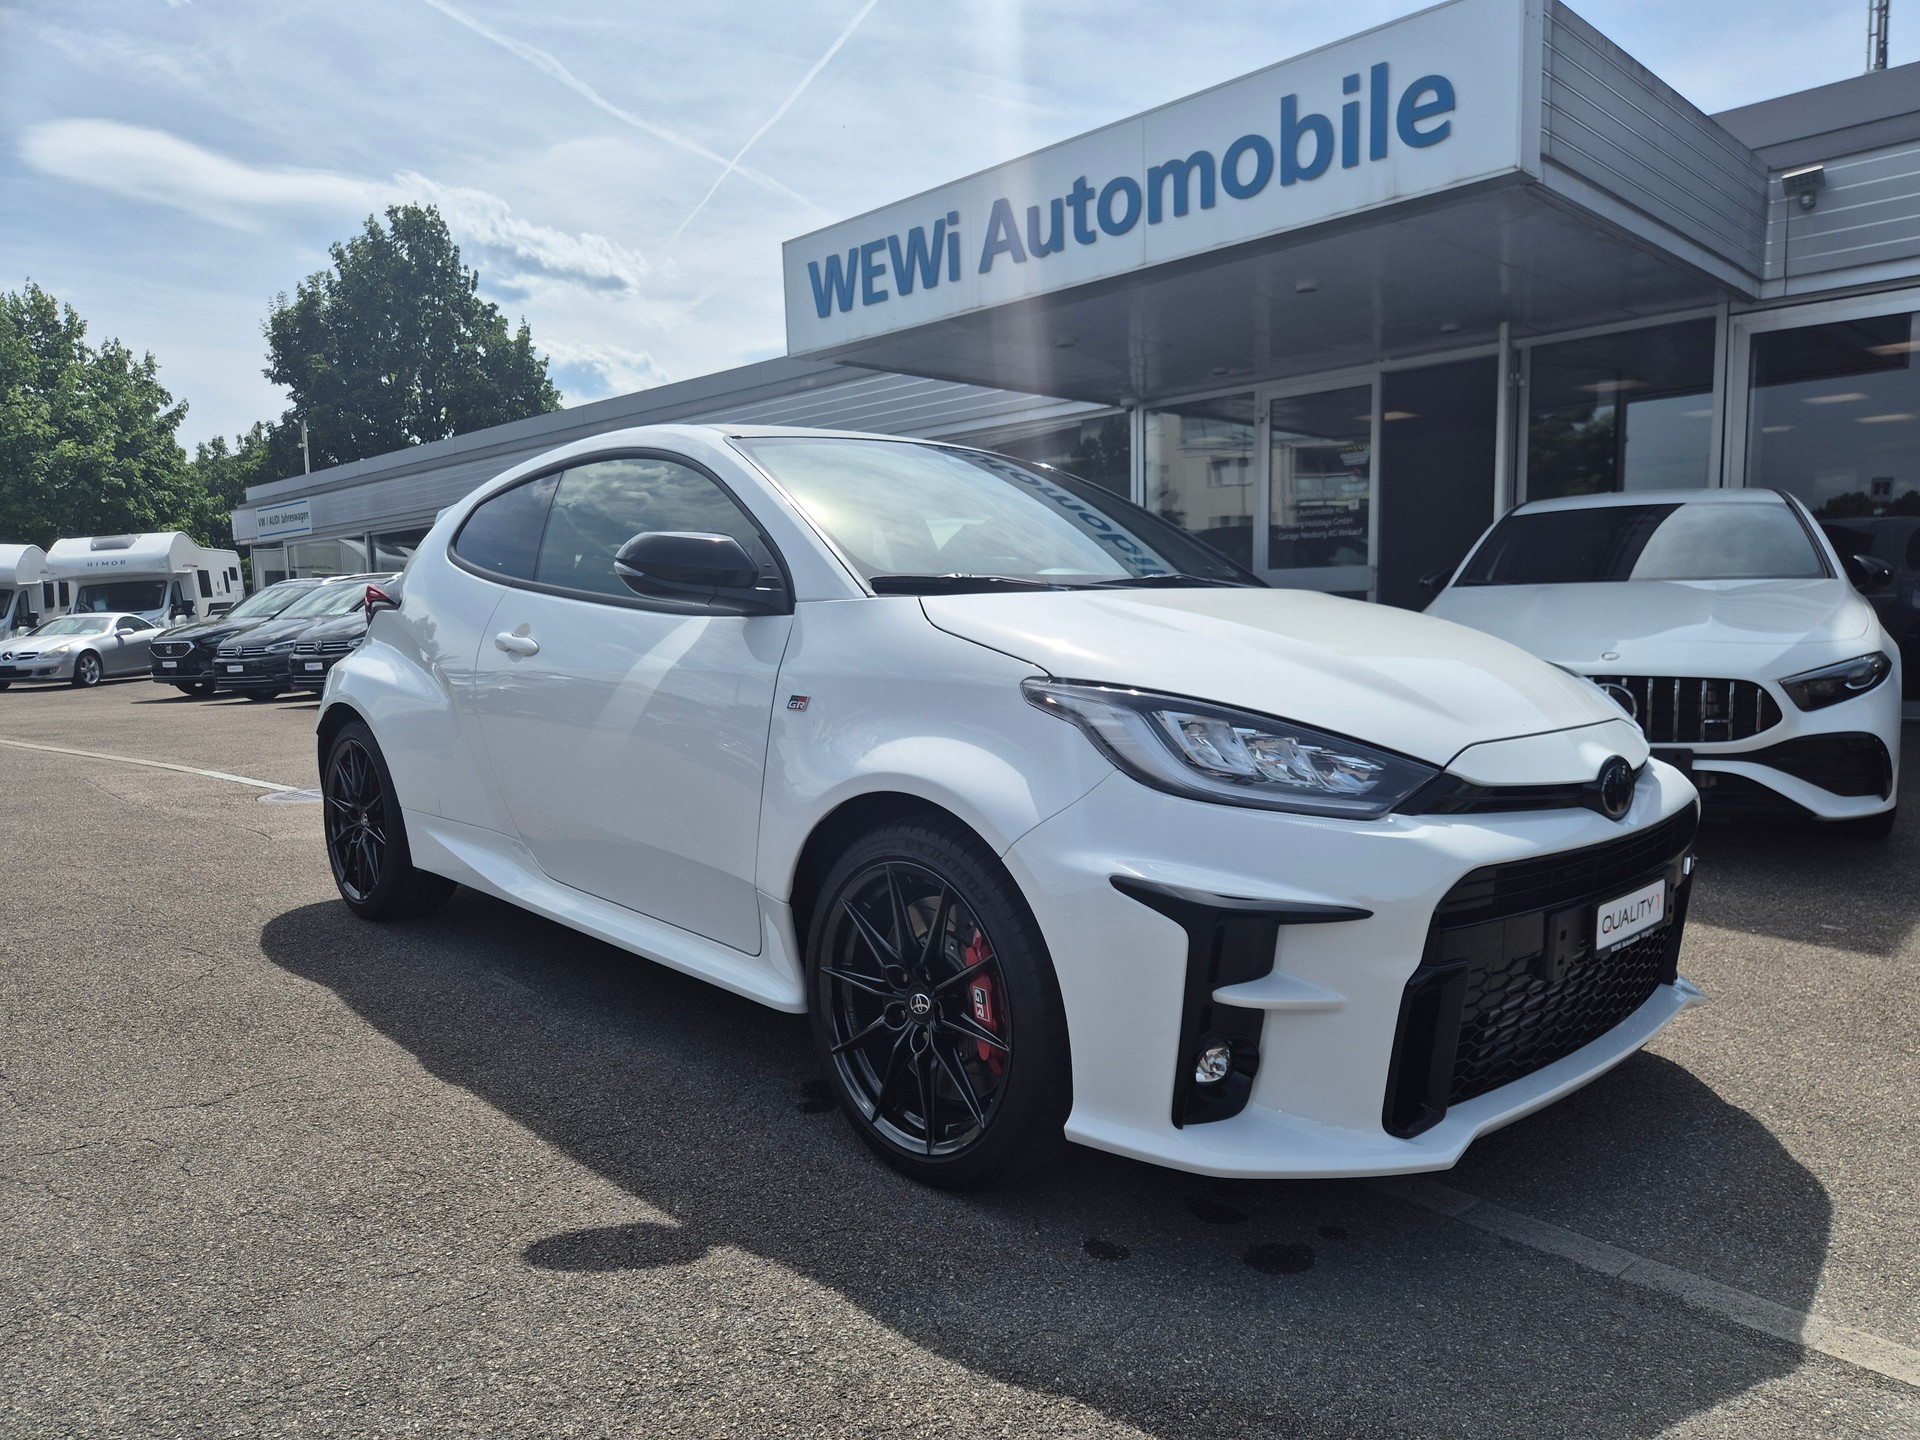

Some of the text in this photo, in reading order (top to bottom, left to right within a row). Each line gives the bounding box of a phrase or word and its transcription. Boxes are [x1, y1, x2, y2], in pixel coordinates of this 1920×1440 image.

[807, 61, 1456, 319] WEWi Automobile
[257, 517, 266, 527] VW
[270, 514, 280, 525] AUDI
[281, 511, 310, 524] Jahreswagen
[788, 700, 805, 709] GR
[1602, 895, 1655, 935] QUALITY
[974, 988, 985, 1018] GR
